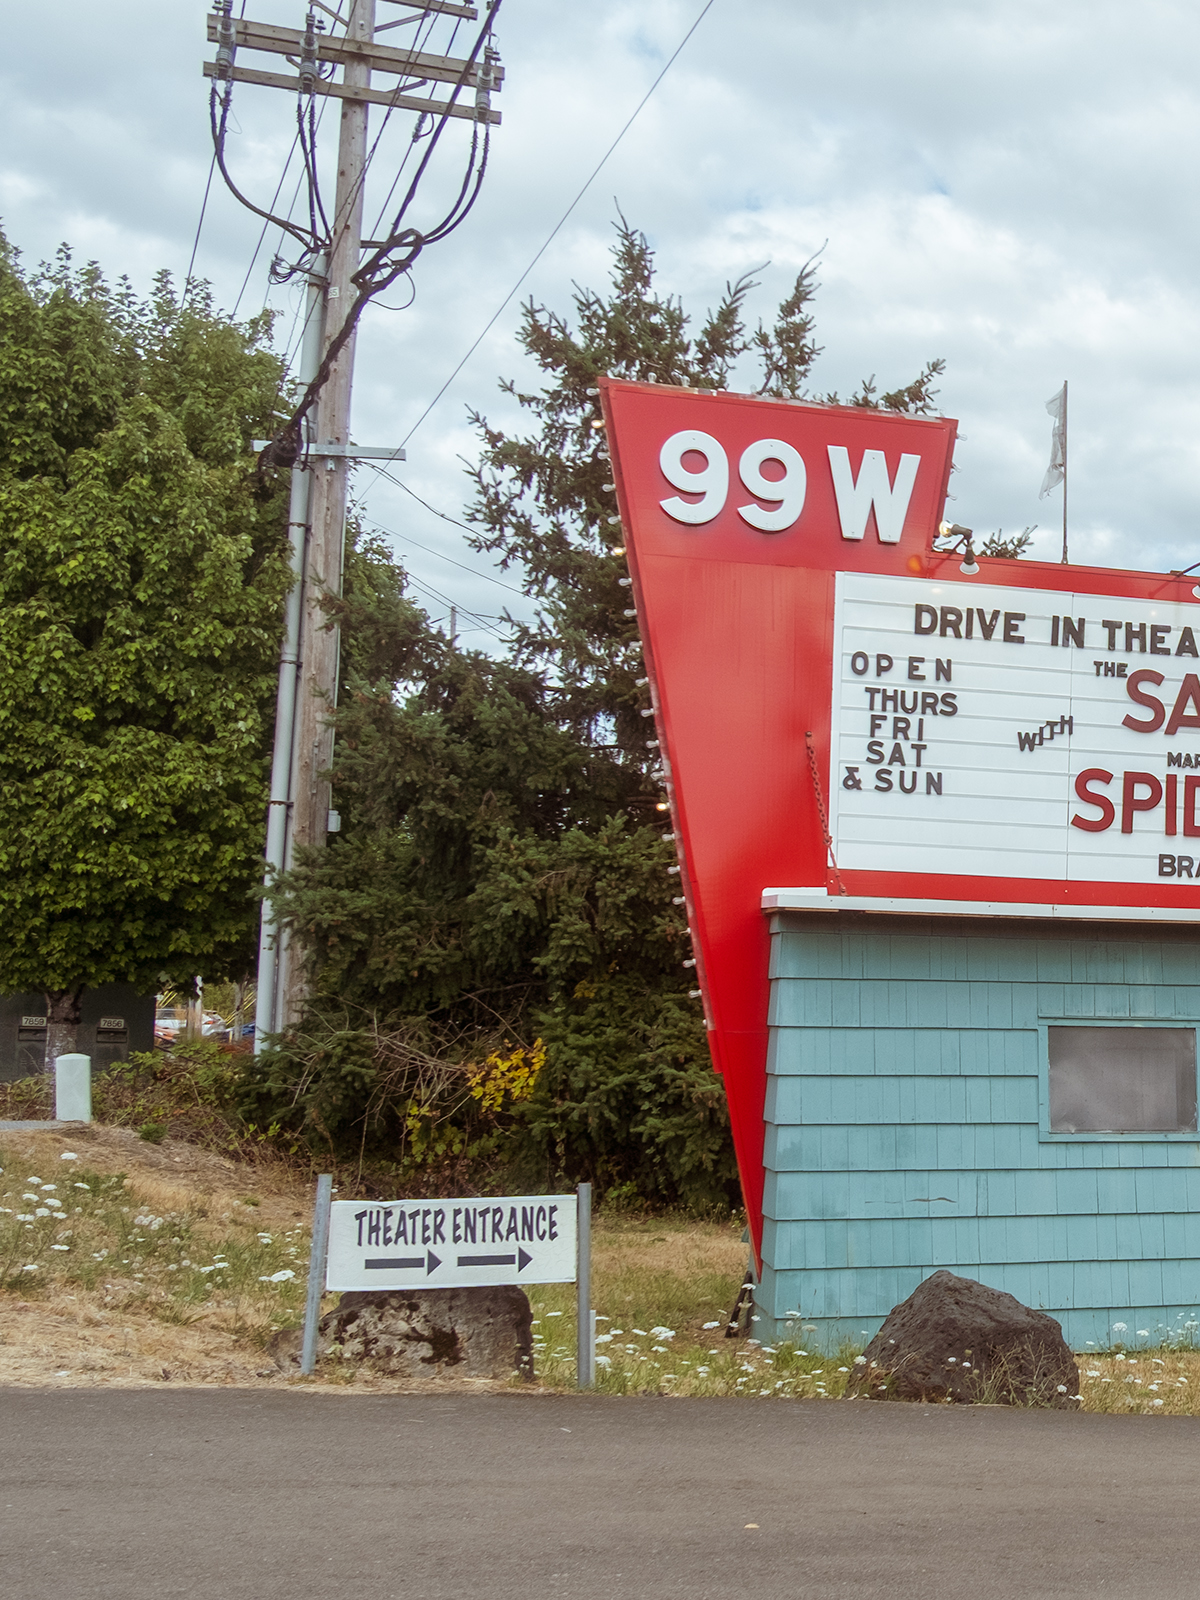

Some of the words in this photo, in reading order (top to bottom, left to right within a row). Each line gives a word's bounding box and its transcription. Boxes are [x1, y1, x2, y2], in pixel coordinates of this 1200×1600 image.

[659, 429, 807, 532] 99
[827, 445, 921, 544] W
[914, 603, 1026, 644] DRIVE
[1051, 615, 1085, 648] IN
[851, 650, 953, 682] OPEN
[1094, 660, 1128, 678] THE
[864, 686, 958, 717] THURS
[870, 714, 924, 742] FRI
[1018, 715, 1073, 752] WITH
[866, 740, 927, 768] SAT
[842, 766, 862, 791] &
[874, 769, 943, 796] SUN
[354, 1208, 446, 1247] THEATER
[452, 1204, 558, 1244] ENTRANCE
